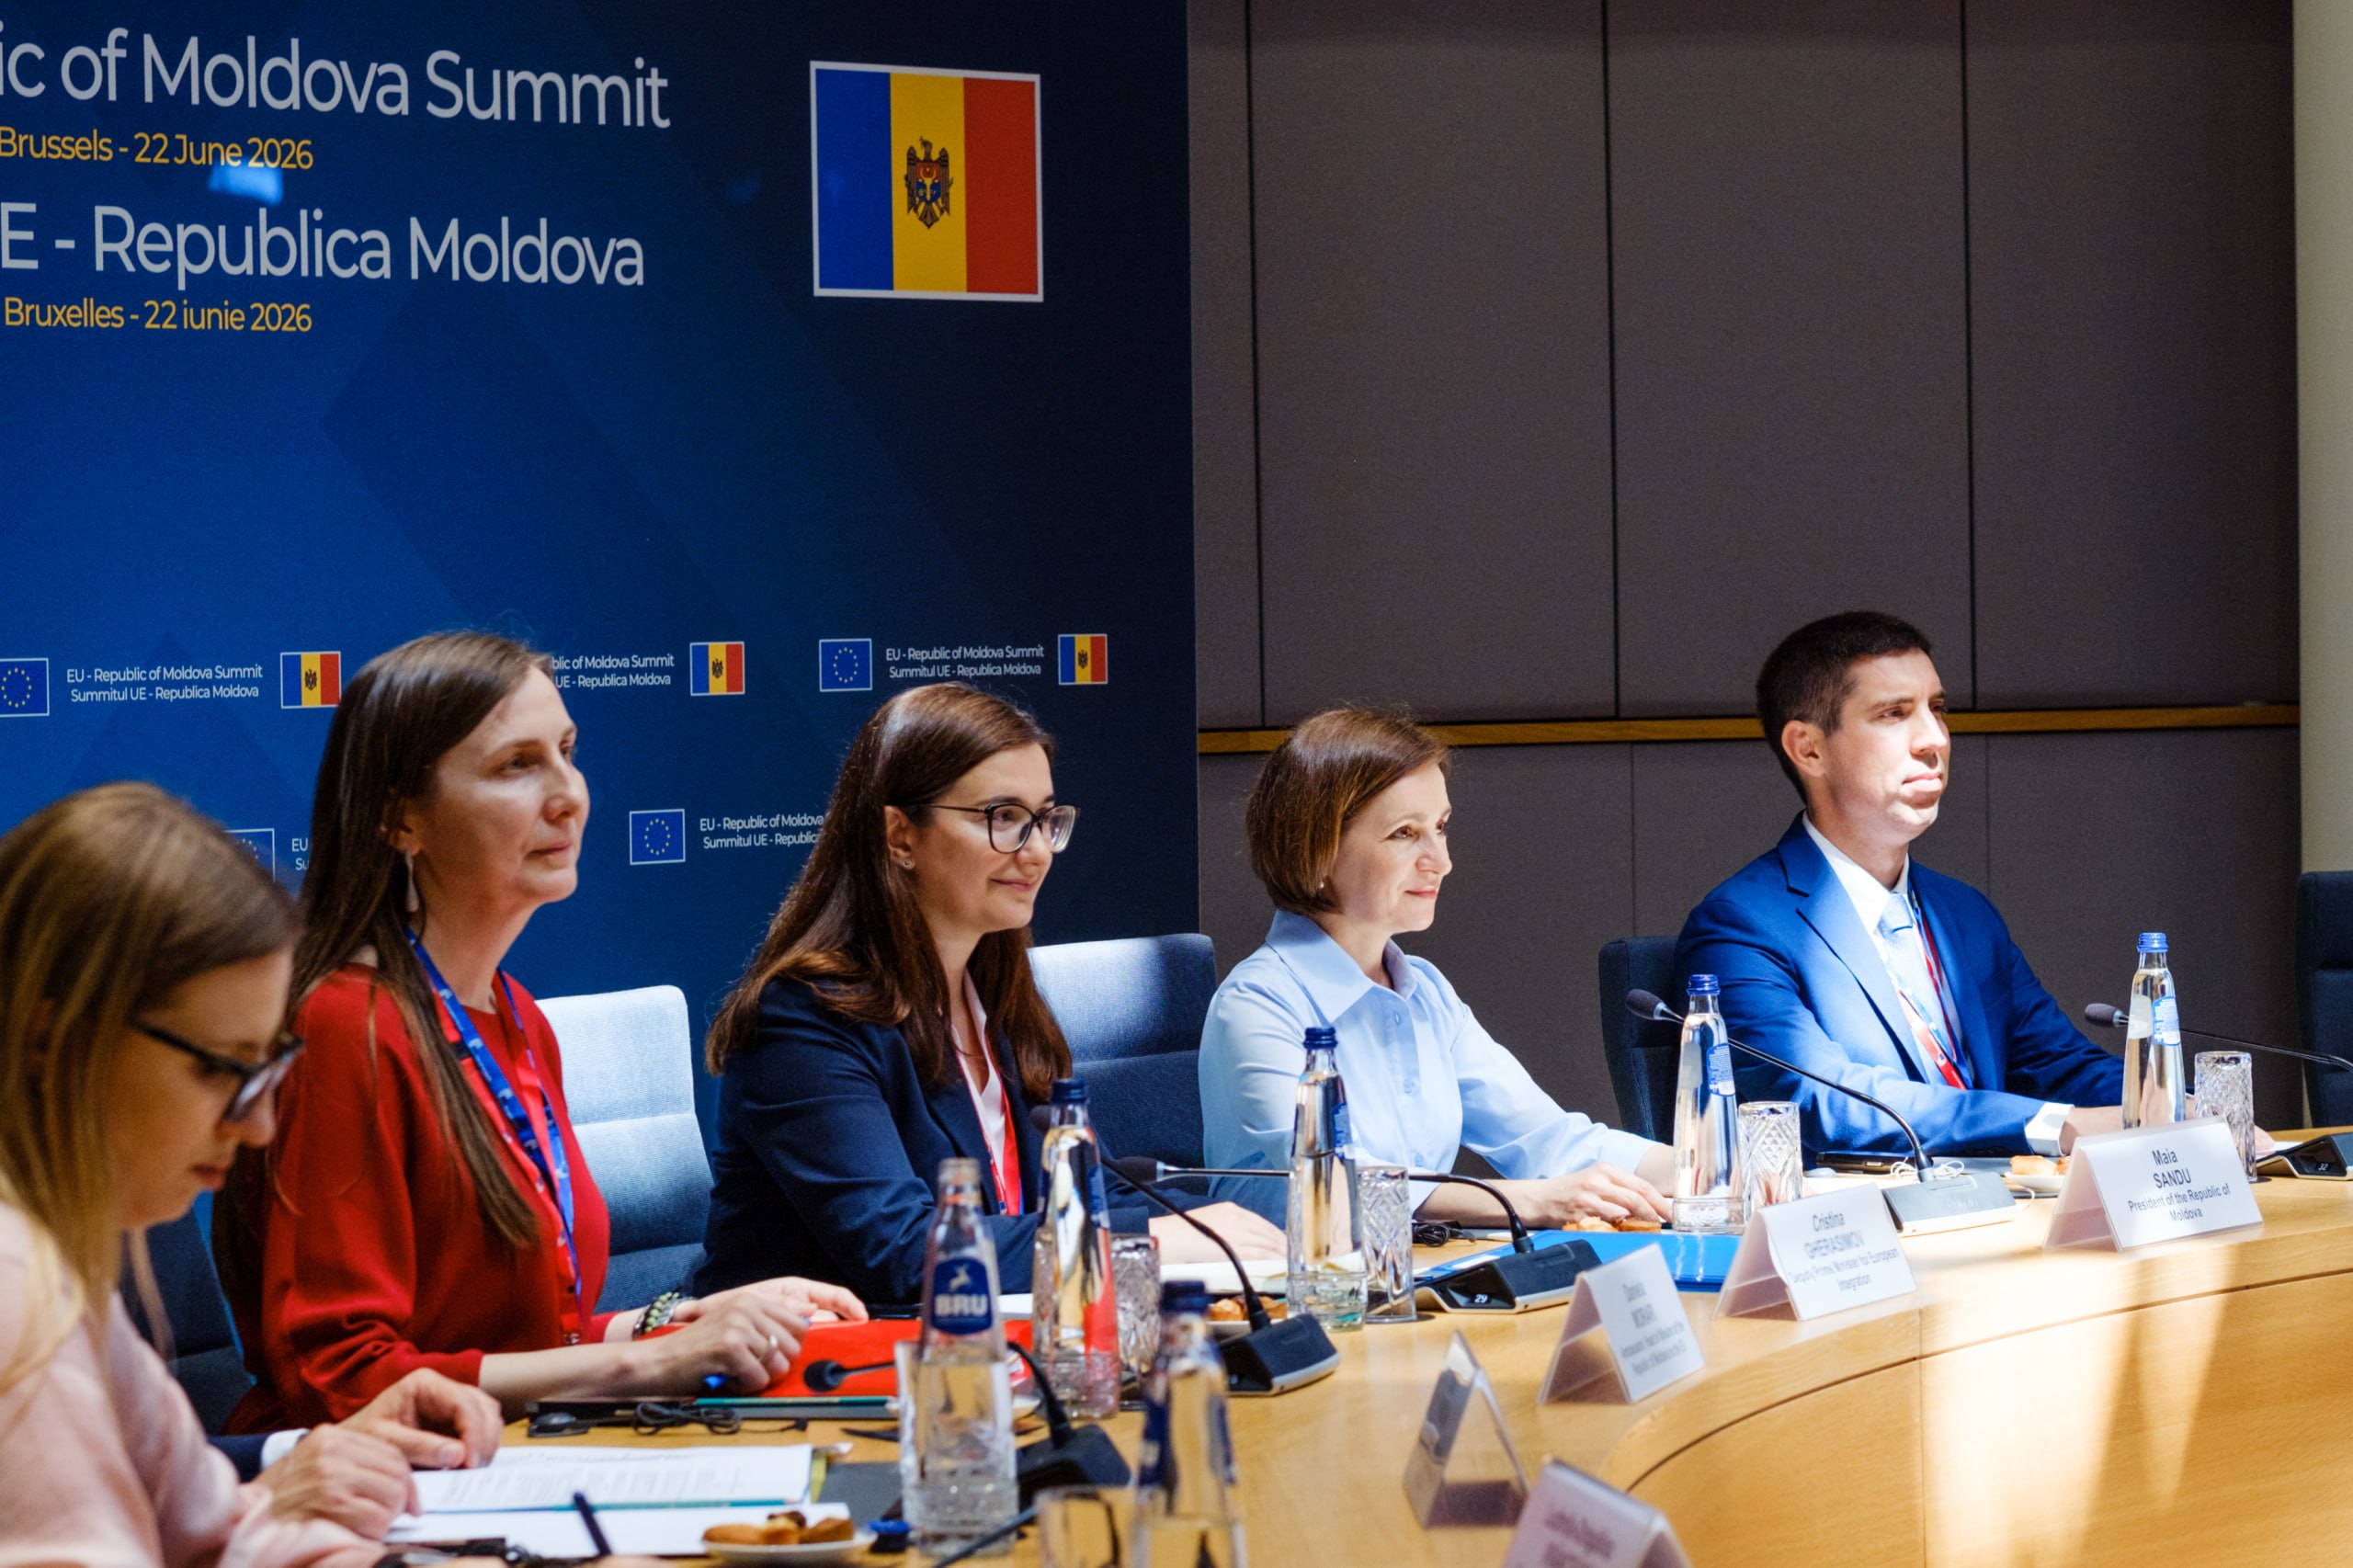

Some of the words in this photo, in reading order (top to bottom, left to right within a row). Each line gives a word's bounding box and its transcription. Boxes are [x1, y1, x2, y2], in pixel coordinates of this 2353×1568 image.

[61, 27, 130, 101] of
[143, 33, 410, 116] Moldova
[426, 50, 671, 129] Summit
[0, 126, 113, 161] Brussels
[134, 132, 169, 164] 22
[174, 134, 243, 166] June
[247, 137, 313, 169] 2026
[95, 205, 391, 290] Republica
[410, 216, 644, 286] Moldova
[4, 297, 124, 328] Bruxelles
[143, 301, 177, 329] 22
[183, 299, 245, 330] iunie
[249, 302, 313, 332] 2026
[572, 655, 584, 669] of
[585, 654, 630, 669] Moldova
[631, 653, 675, 667] Summit
[885, 648, 901, 661] EU
[908, 646, 950, 662] Republic
[952, 646, 962, 659] of
[963, 645, 1004, 659] Moldova
[1005, 643, 1044, 658] Summit
[67, 668, 85, 683] EU
[95, 666, 146, 685] Republic
[149, 666, 161, 681] of
[163, 665, 212, 681] Moldova
[215, 664, 263, 679] Summit
[889, 665, 936, 678] Summitul
[937, 665, 950, 677] UE
[957, 663, 1002, 678] Republica
[1003, 662, 1041, 676] Moldova
[555, 675, 571, 688] UE
[578, 673, 627, 689] Republica
[629, 672, 671, 687] Moldova
[71, 687, 128, 702] Summitul
[131, 687, 147, 700] UE
[155, 686, 210, 702] Republica
[213, 684, 259, 699] Moldova
[699, 817, 715, 831] EU
[722, 814, 767, 832] Republic
[768, 814, 780, 827] of
[781, 812, 824, 827] Moldova
[291, 837, 309, 852] EU
[703, 834, 752, 849] Summitul
[753, 834, 767, 846] UE
[2152, 1148, 2178, 1165] Maia
[2317, 1163, 2328, 1171] 32
[2153, 1167, 2191, 1188] SANDU
[2127, 1197, 2165, 1213] President
[2166, 1193, 2175, 1206] of
[2175, 1192, 2187, 1205] the
[2187, 1186, 2222, 1201] Republic
[2222, 1183, 2231, 1197] of
[1812, 1211, 1846, 1233] Cristina
[2169, 1207, 2203, 1221] Moldova
[935, 1293, 988, 1316] BRU
[1474, 1293, 1488, 1303] 29
